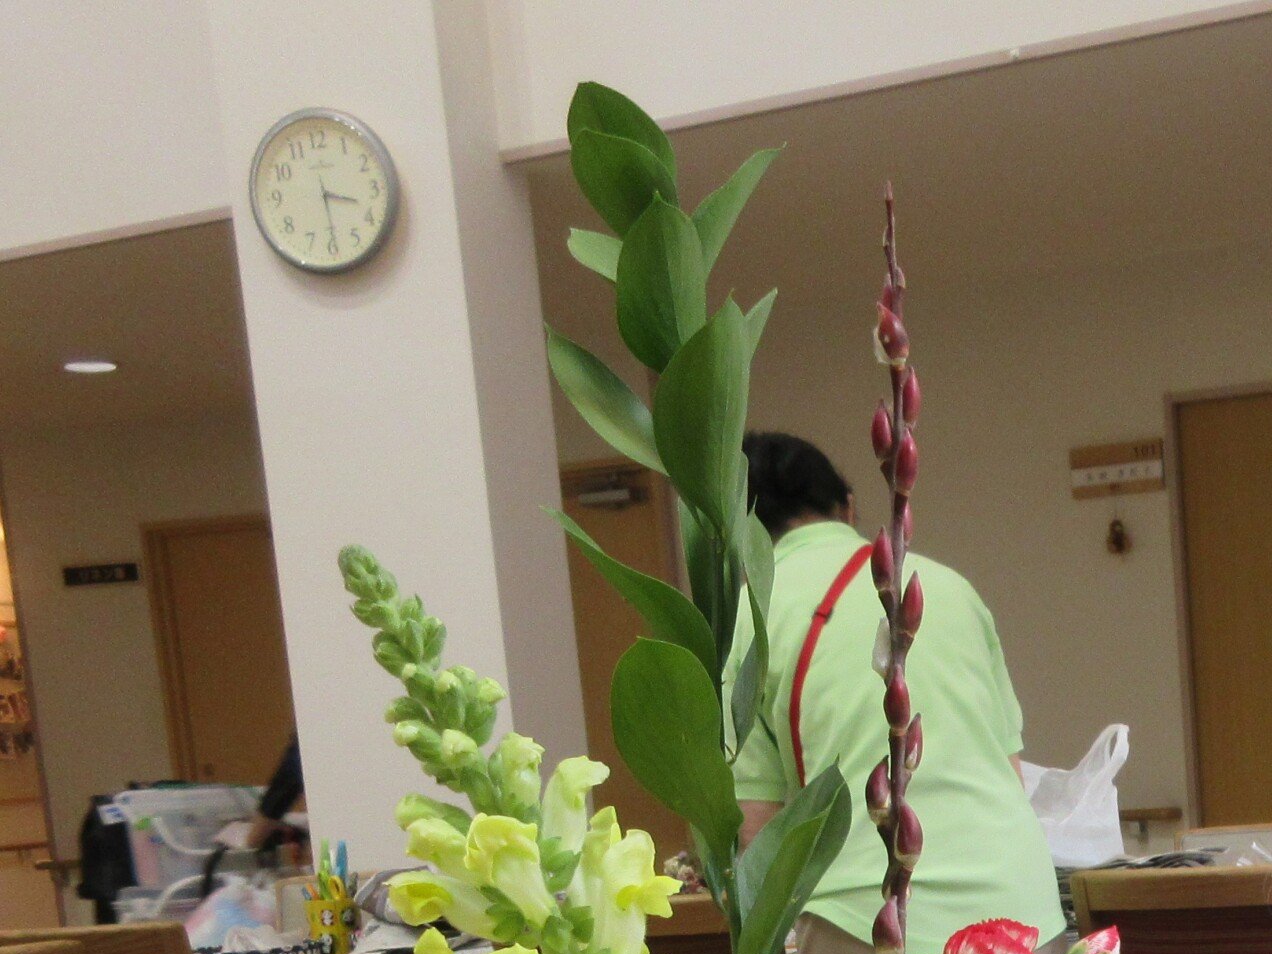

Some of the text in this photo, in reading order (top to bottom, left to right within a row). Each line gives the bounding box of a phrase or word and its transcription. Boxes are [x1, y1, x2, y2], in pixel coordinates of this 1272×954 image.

[309, 130, 326, 149] 12
[341, 138, 347, 154] 1
[289, 138, 304, 160] 11
[359, 154, 369, 172] 2
[275, 164, 291, 181] 10
[271, 190, 282, 207] 9
[368, 180, 380, 199] 3
[284, 216, 294, 233] 8
[365, 208, 374, 225] 4
[305, 232, 315, 252] 7
[351, 228, 360, 246] 5
